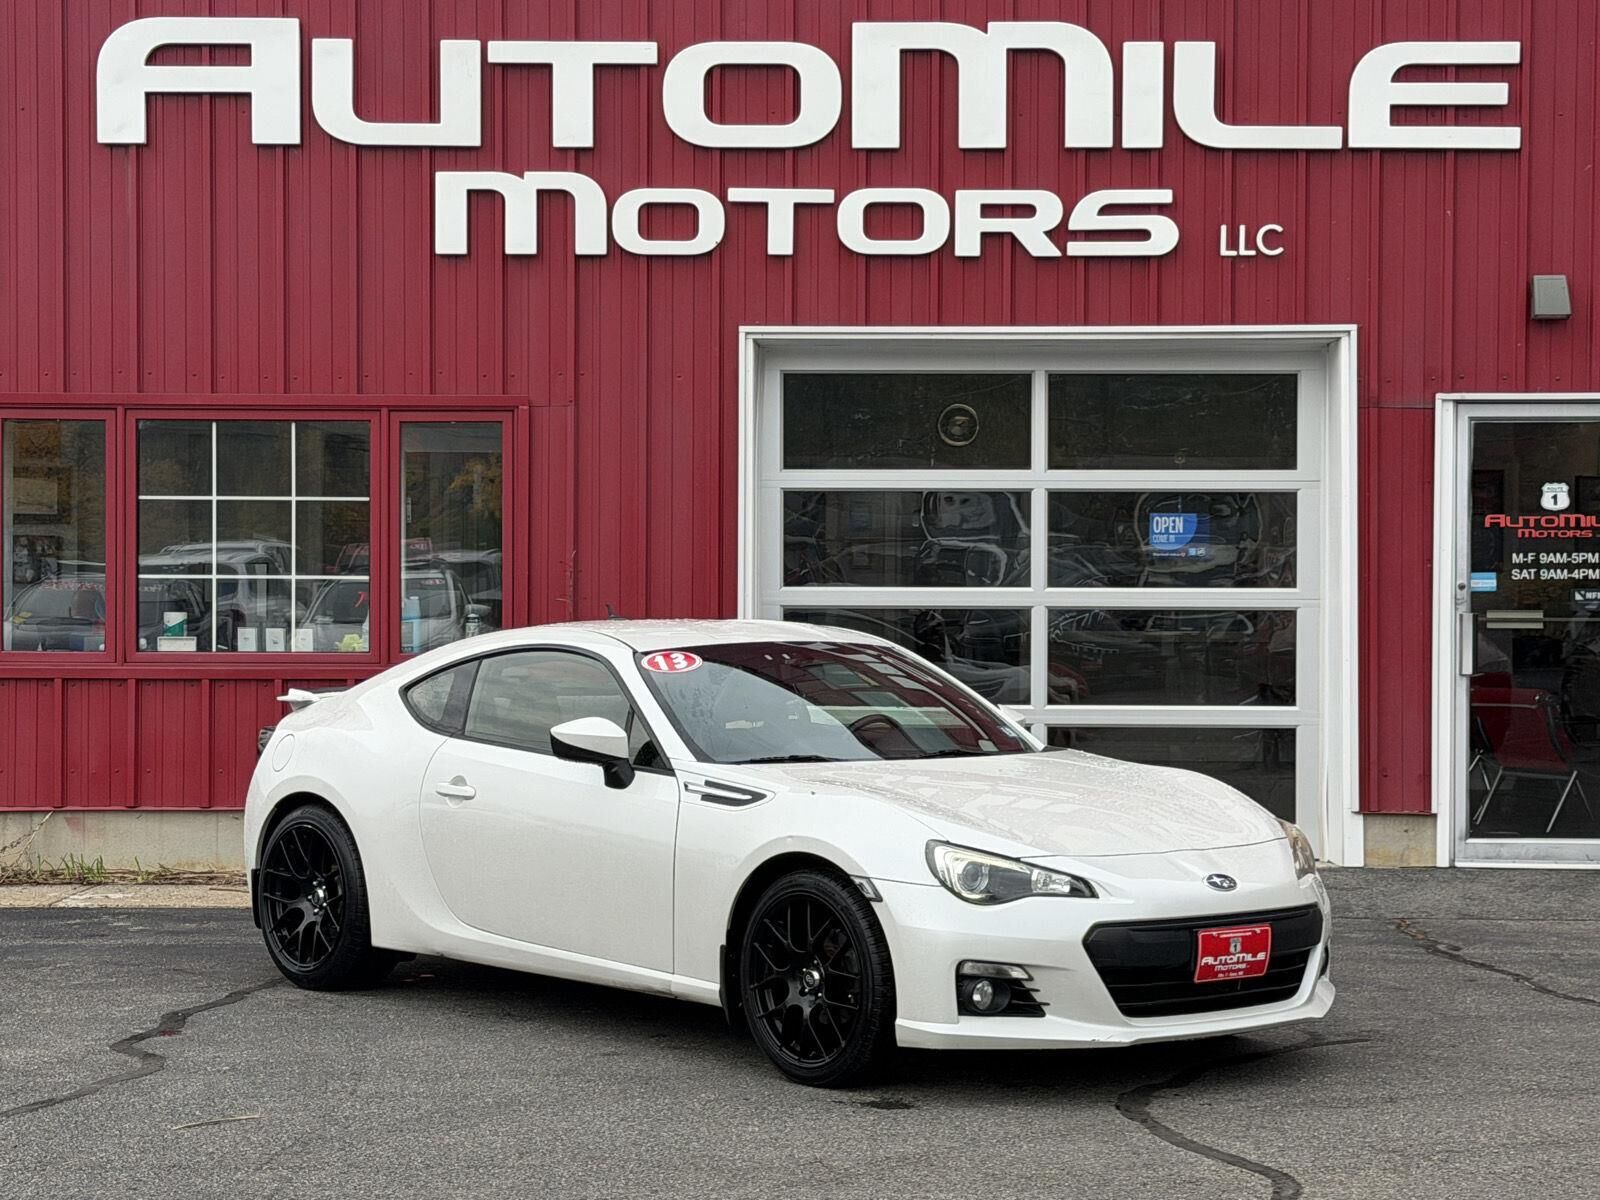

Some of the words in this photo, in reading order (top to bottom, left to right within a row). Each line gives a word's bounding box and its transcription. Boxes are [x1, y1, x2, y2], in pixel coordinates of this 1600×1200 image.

[96, 17, 1522, 149] AUTOMILE
[434, 171, 1180, 257] MOTORS
[1219, 223, 1284, 257] LLC
[1550, 493, 1558, 506] 1
[1152, 516, 1184, 534] OPEN
[1517, 529, 1593, 538] MOTORS
[1511, 552, 1536, 564] M-F
[1539, 552, 1600, 564] 9AM-5PM
[1511, 568, 1538, 580] SAT
[1540, 568, 1600, 580] 9AM-4PM
[653, 653, 689, 671] 13
[1201, 951, 1267, 966] AUTOMILE
